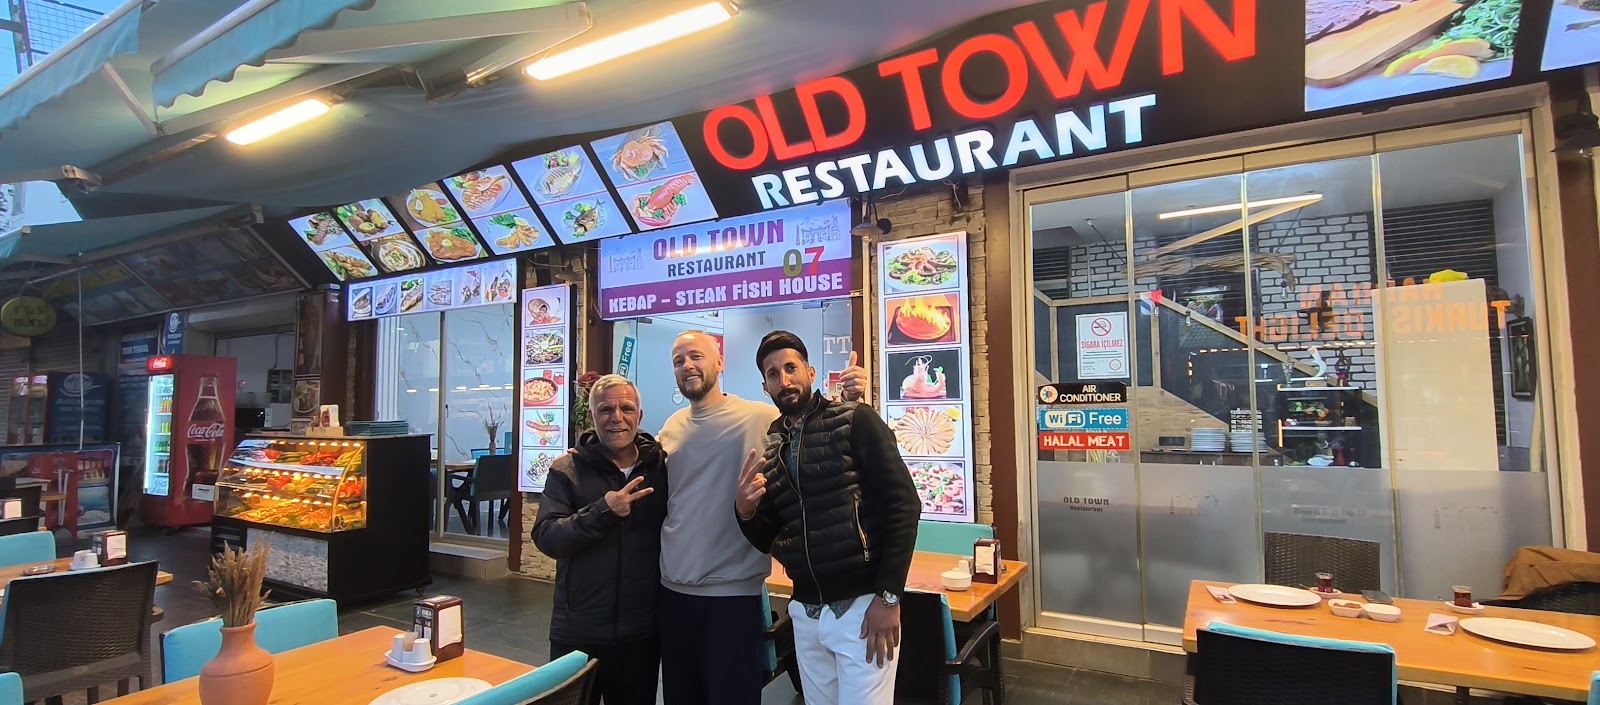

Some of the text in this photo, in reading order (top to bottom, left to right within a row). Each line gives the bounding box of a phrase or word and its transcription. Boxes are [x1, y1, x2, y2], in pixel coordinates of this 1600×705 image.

[702, 0, 1257, 171] OLD TOWN
[750, 93, 1157, 210] RESTAURANT
[652, 218, 785, 261] OLD TOWN
[667, 250, 767, 278] RESTAURANT
[783, 245, 826, 277] 07
[608, 294, 657, 314] KEBAP
[675, 285, 727, 307] STEAK
[779, 272, 844, 296] HOUSE
[621, 340, 633, 363] Free
[1060, 393, 1121, 402] CONDITIONER
[1082, 384, 1097, 393] AIR
[1089, 412, 1122, 425] Free
[1043, 435, 1125, 447] HALAL MEAT
[1063, 496, 1110, 506] OLD TOWN
